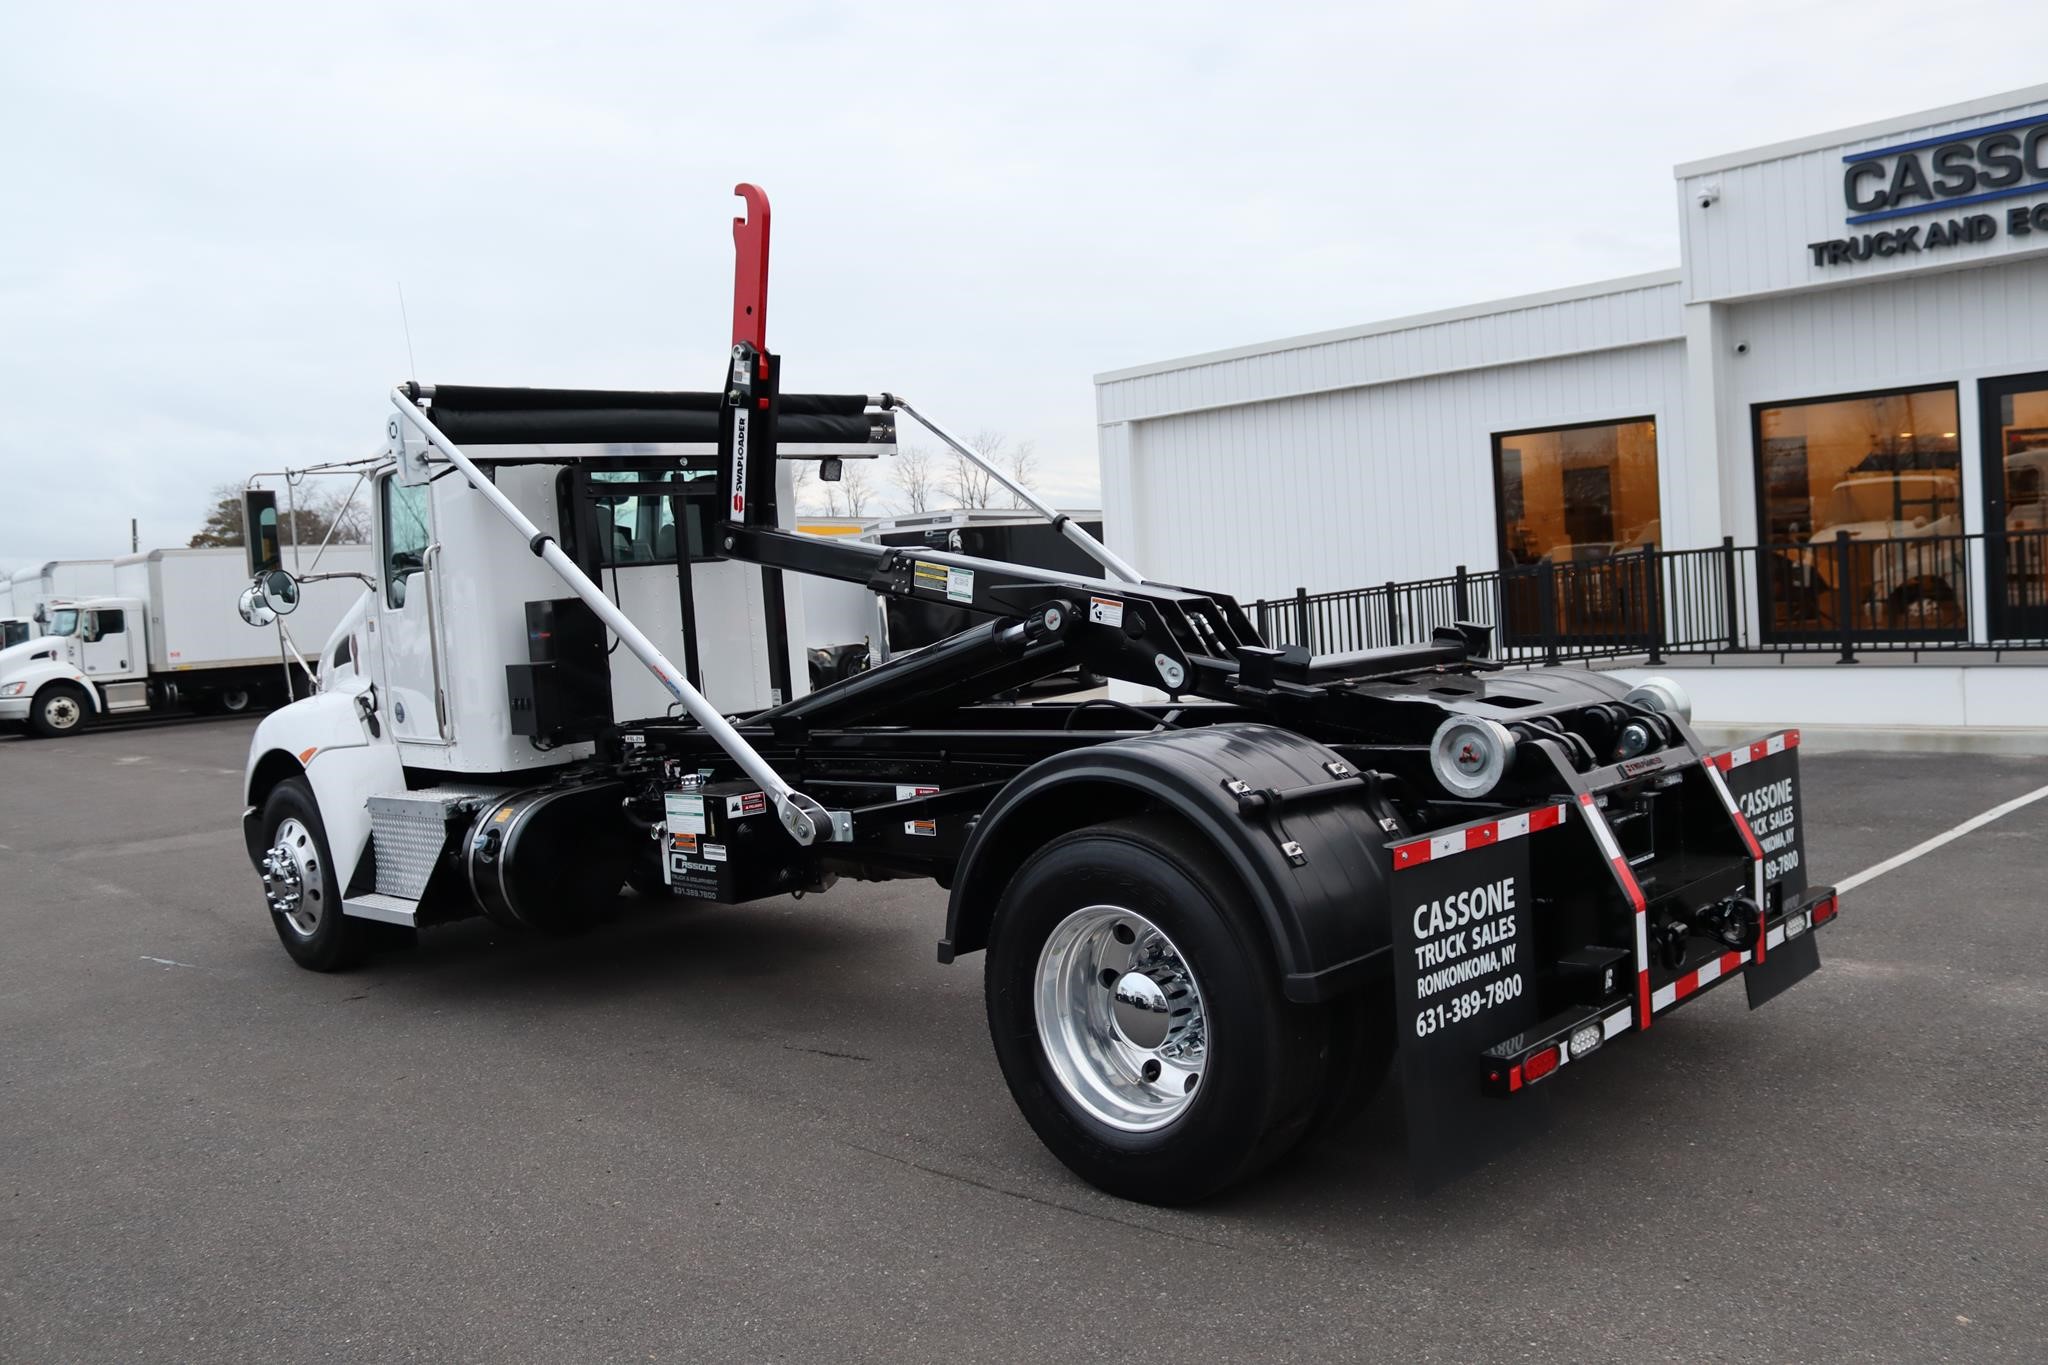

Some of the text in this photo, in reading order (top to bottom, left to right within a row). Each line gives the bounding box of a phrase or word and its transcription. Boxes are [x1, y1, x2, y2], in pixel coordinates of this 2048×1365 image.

[1808, 226, 1922, 266] TRUCK
[1923, 213, 1997, 249] AND
[735, 417, 746, 492] SWAPLOADER
[1769, 806, 1794, 831] SALES
[1765, 850, 1799, 880] 89-7800
[1413, 877, 1516, 939] CASSONE
[1415, 915, 1517, 970] TRUCK SALES
[1417, 943, 1517, 999] RONKONKOMA, NY
[1416, 973, 1523, 1038] 631-389-7800
